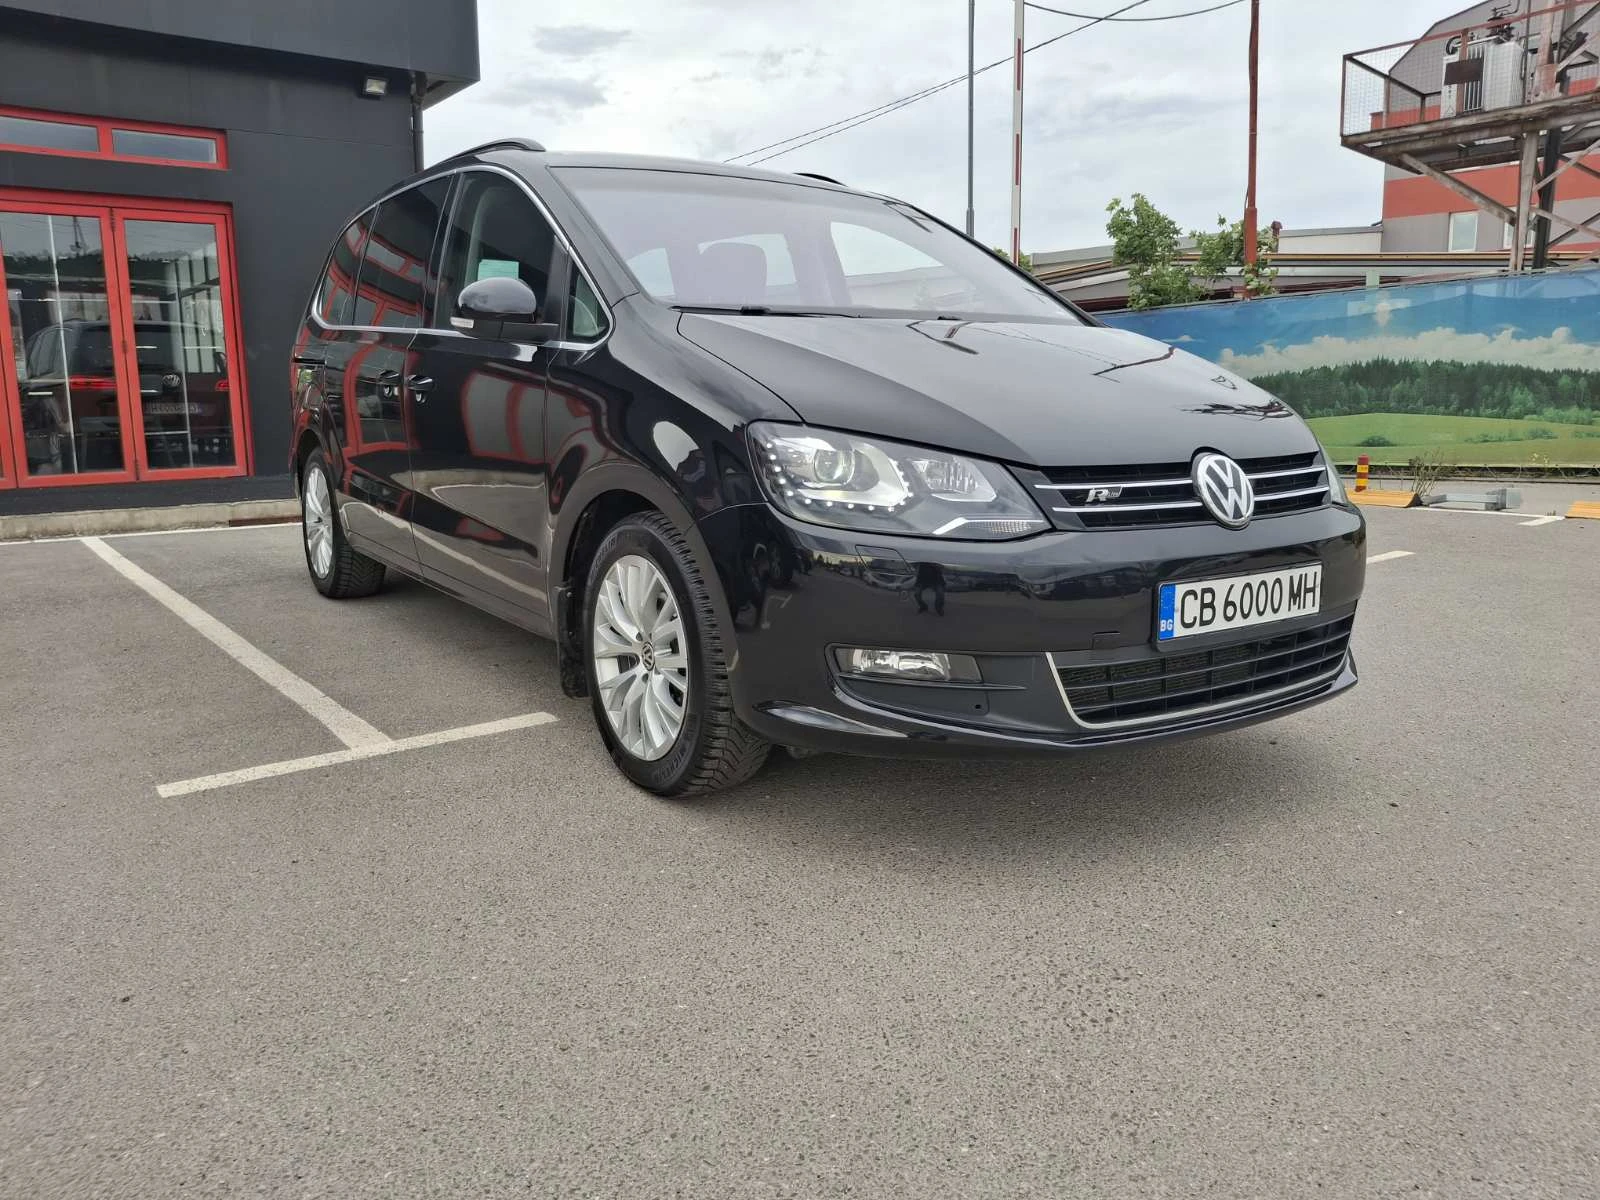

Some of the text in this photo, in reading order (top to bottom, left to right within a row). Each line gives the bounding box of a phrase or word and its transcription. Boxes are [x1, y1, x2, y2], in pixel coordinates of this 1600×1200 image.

[1198, 455, 1254, 524] VW
[1160, 618, 1174, 632] BG
[1180, 571, 1318, 629] CB 6000 MH
